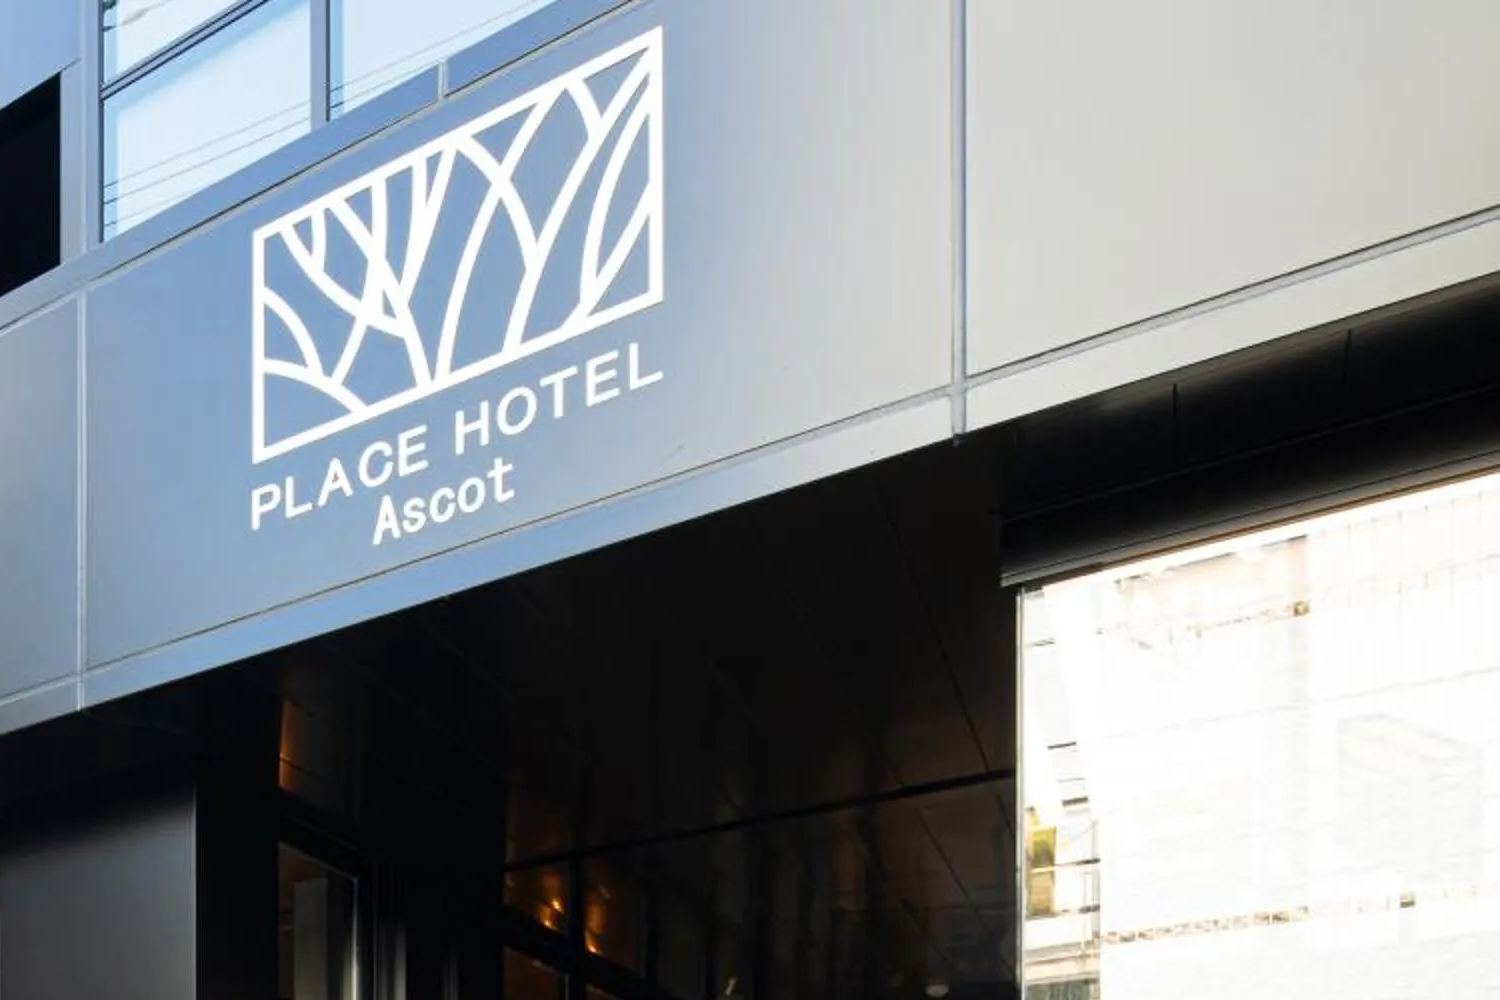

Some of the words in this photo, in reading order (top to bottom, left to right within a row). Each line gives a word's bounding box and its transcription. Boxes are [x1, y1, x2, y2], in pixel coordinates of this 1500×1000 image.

[251, 424, 429, 531] PLACE
[455, 342, 664, 456] HOTEL
[372, 457, 516, 545] Ascot
